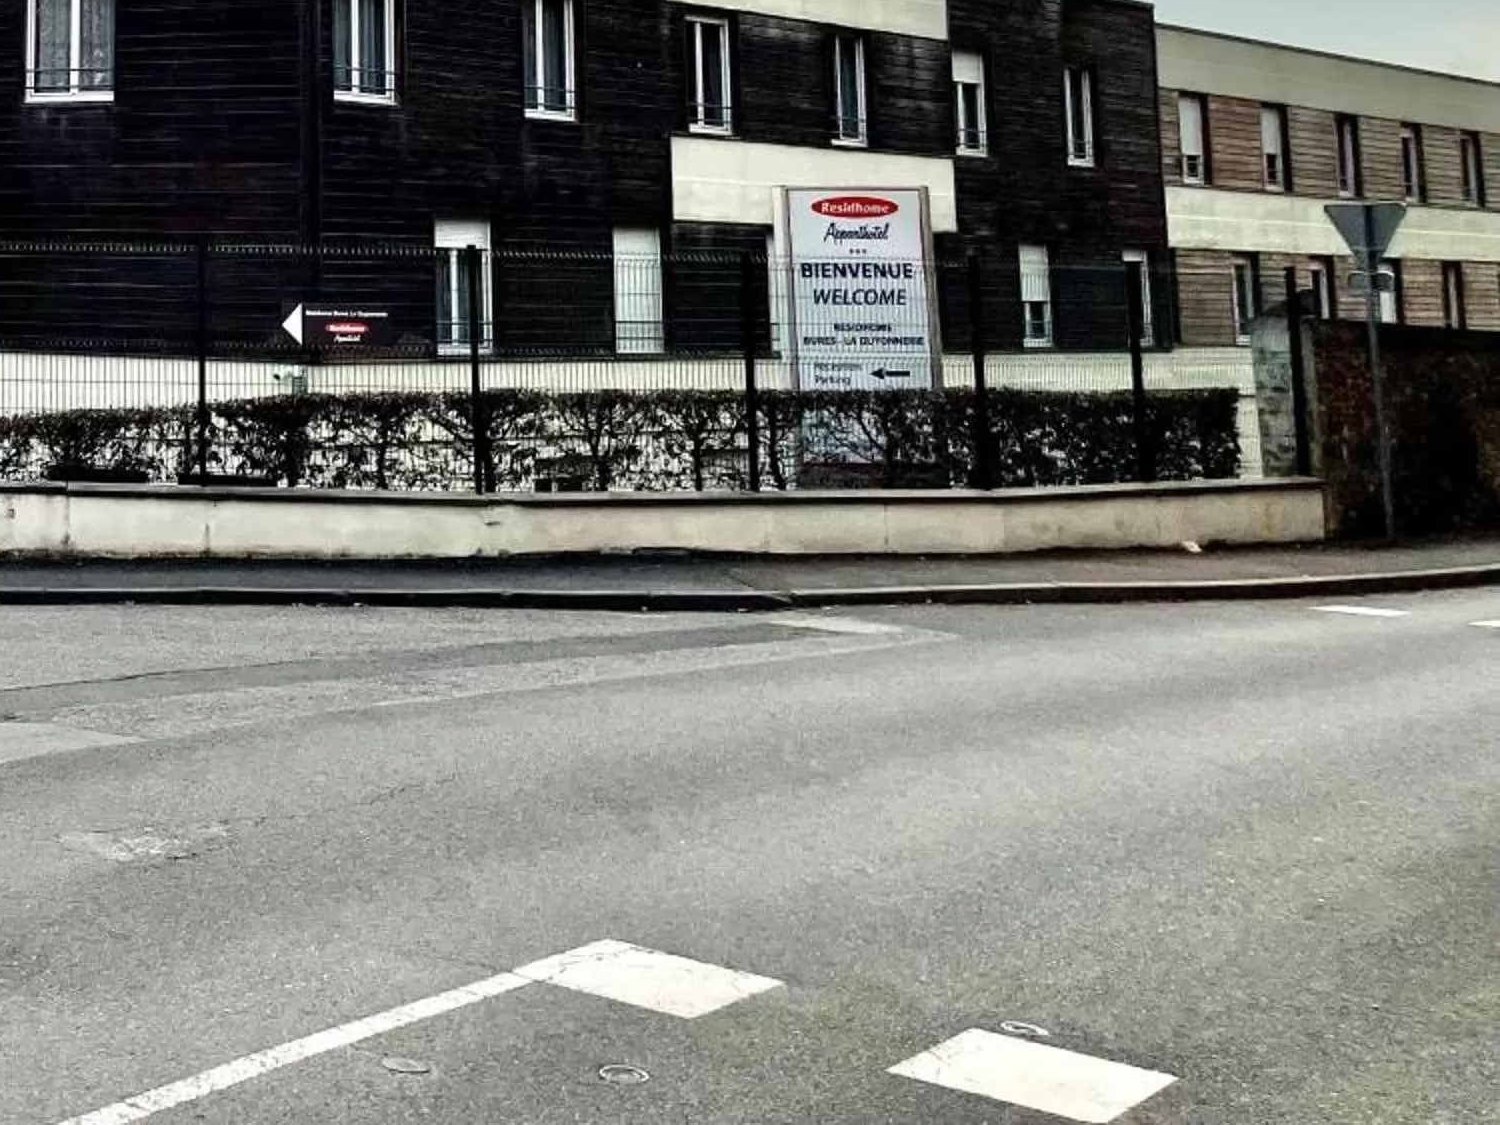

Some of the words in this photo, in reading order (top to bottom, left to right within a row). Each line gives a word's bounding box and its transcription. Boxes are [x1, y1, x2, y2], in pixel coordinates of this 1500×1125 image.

[821, 202, 889, 214] Residhome
[801, 262, 913, 279] BIENVENUE
[813, 288, 907, 306] WELCOME
